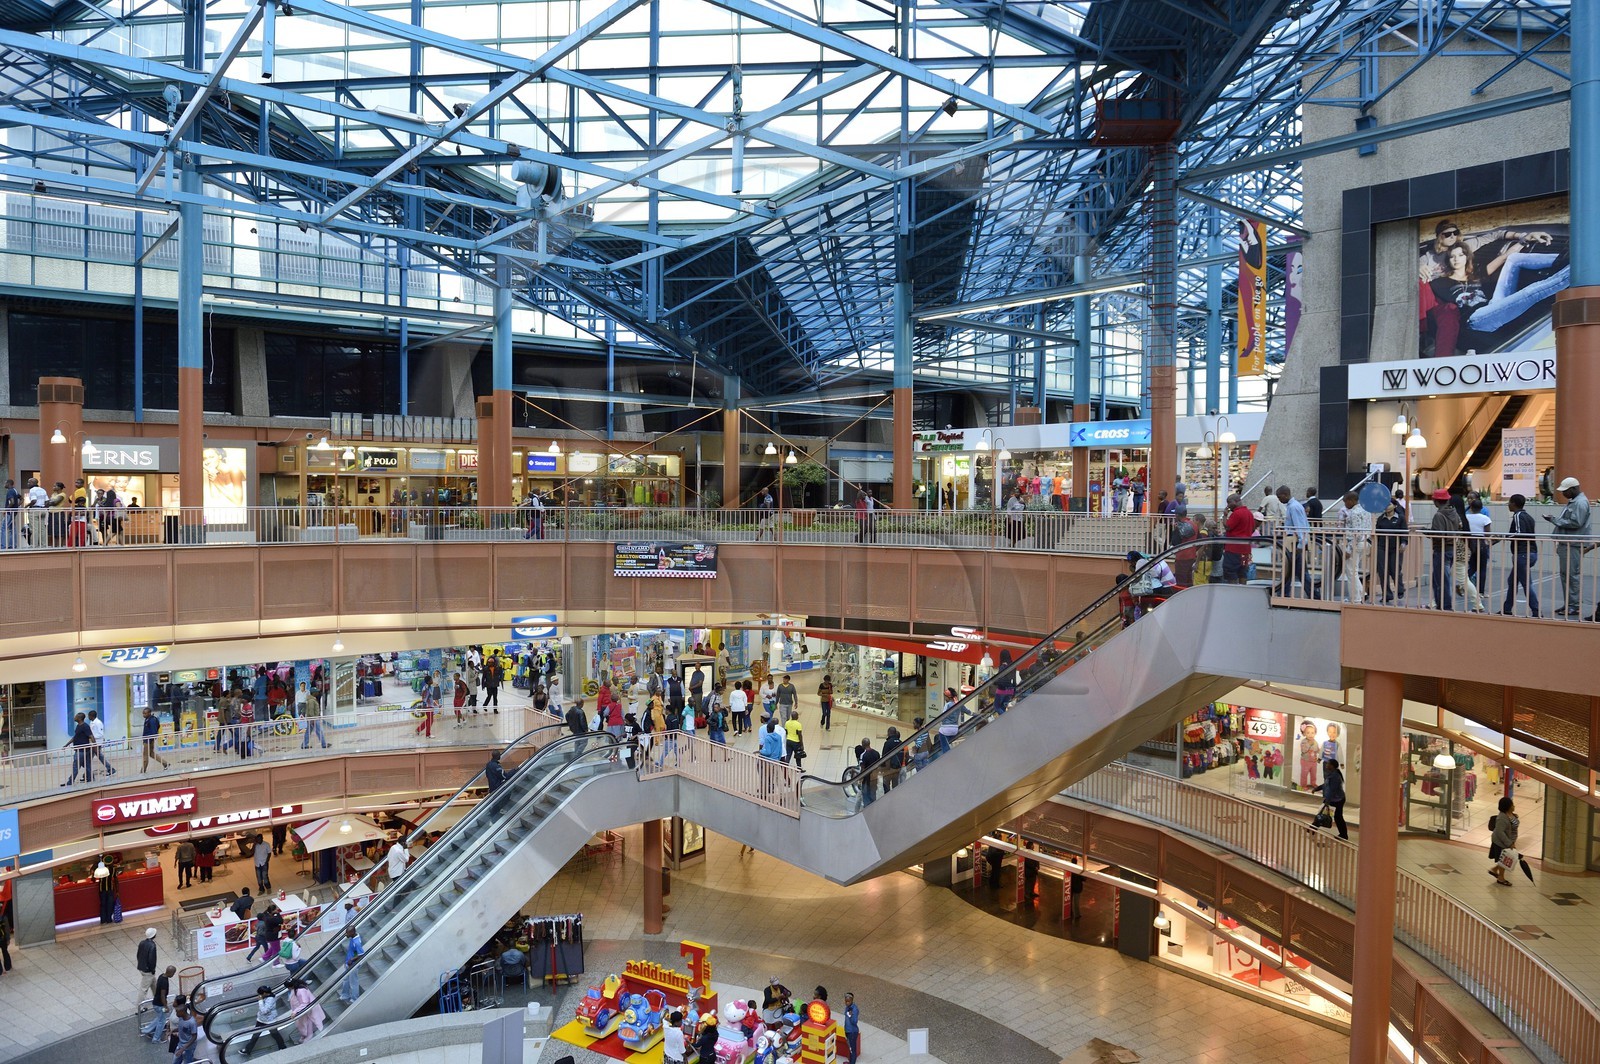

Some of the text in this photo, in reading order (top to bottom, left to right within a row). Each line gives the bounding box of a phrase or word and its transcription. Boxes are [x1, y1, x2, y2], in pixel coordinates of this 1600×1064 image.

[1251, 275, 1264, 372] For people on the go
[1094, 429, 1130, 439] CROSS
[88, 450, 153, 466] ERNS
[1504, 448, 1533, 456] BACK
[374, 457, 398, 465] POLO
[107, 646, 158, 663] PEP
[118, 793, 195, 819] WIMPY
